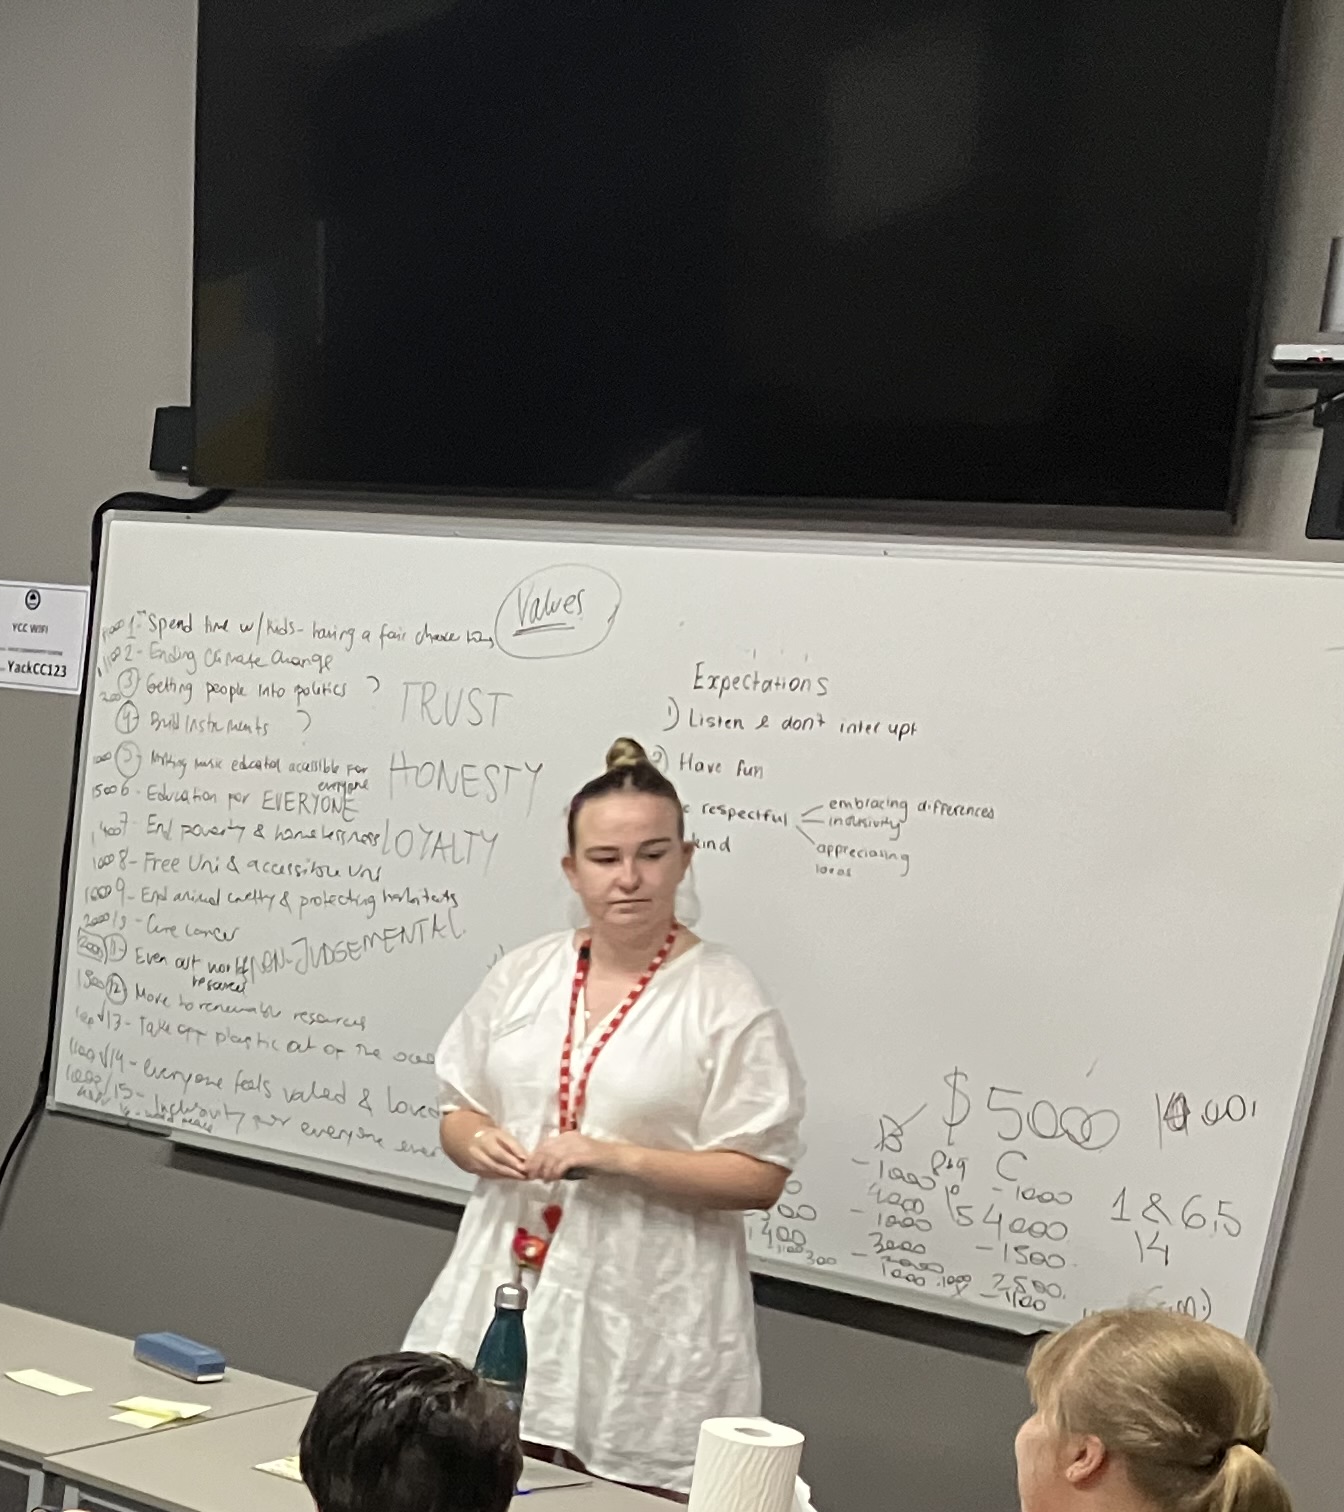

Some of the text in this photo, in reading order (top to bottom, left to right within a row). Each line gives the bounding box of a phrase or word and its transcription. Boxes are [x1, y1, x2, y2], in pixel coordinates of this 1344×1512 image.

[516, 586, 586, 627] Values
[11, 622, 29, 634] YCC
[148, 611, 192, 644] Spend
[8, 660, 67, 678] YackCC123
[149, 640, 198, 676] Ending
[692, 660, 830, 698] Expectations
[401, 681, 513, 727] TRUST
[688, 707, 745, 731] Listen
[679, 751, 723, 775] Have
[735, 759, 764, 779] fun
[389, 750, 543, 819] HONESTY
[146, 783, 218, 807] Education
[260, 787, 360, 824] EVERYONE
[701, 802, 789, 828] respectful
[828, 796, 909, 824] embracing
[144, 850, 182, 876] Free
[226, 852, 241, 873] &
[135, 943, 169, 966] Even
[358, 1087, 373, 1117] &
[996, 1149, 1029, 1183] C
[1141, 1192, 1174, 1227] &
